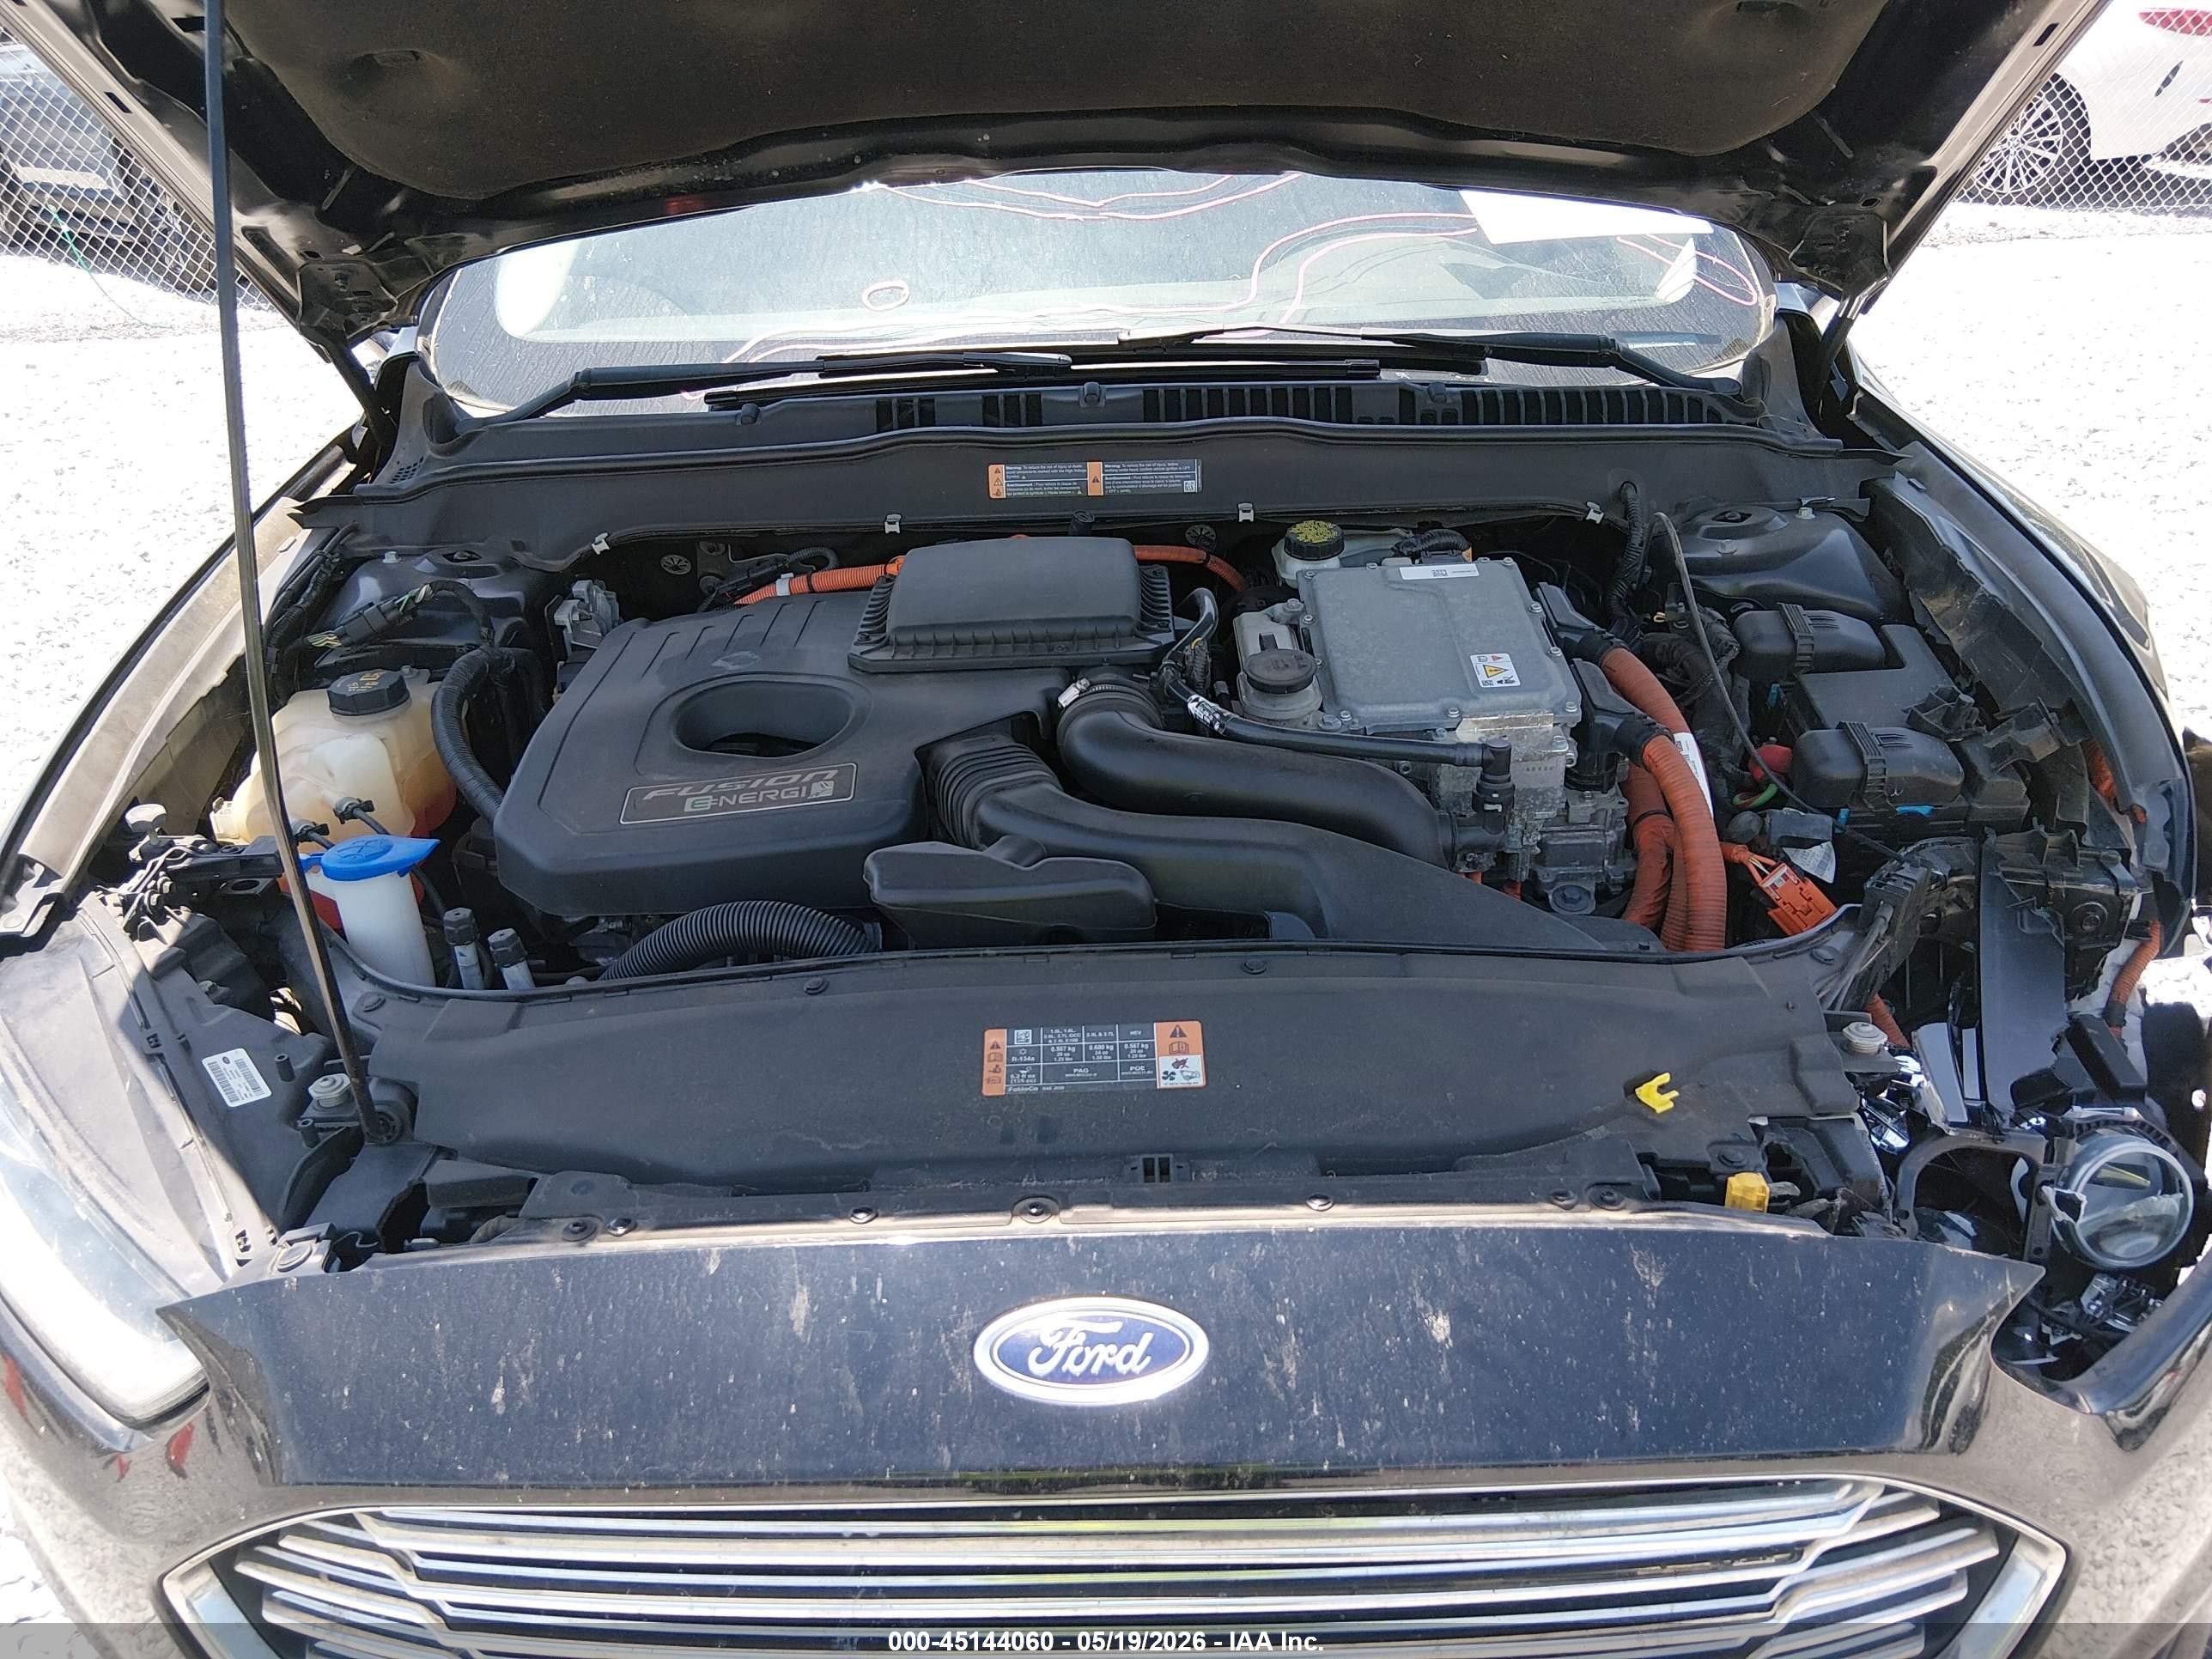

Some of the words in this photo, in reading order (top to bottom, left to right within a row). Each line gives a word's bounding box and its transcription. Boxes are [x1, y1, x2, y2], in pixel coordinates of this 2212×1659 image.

[643, 769, 838, 800] FUSION
[684, 787, 806, 812] ENERGI
[1027, 1319, 1155, 1376] Ford
